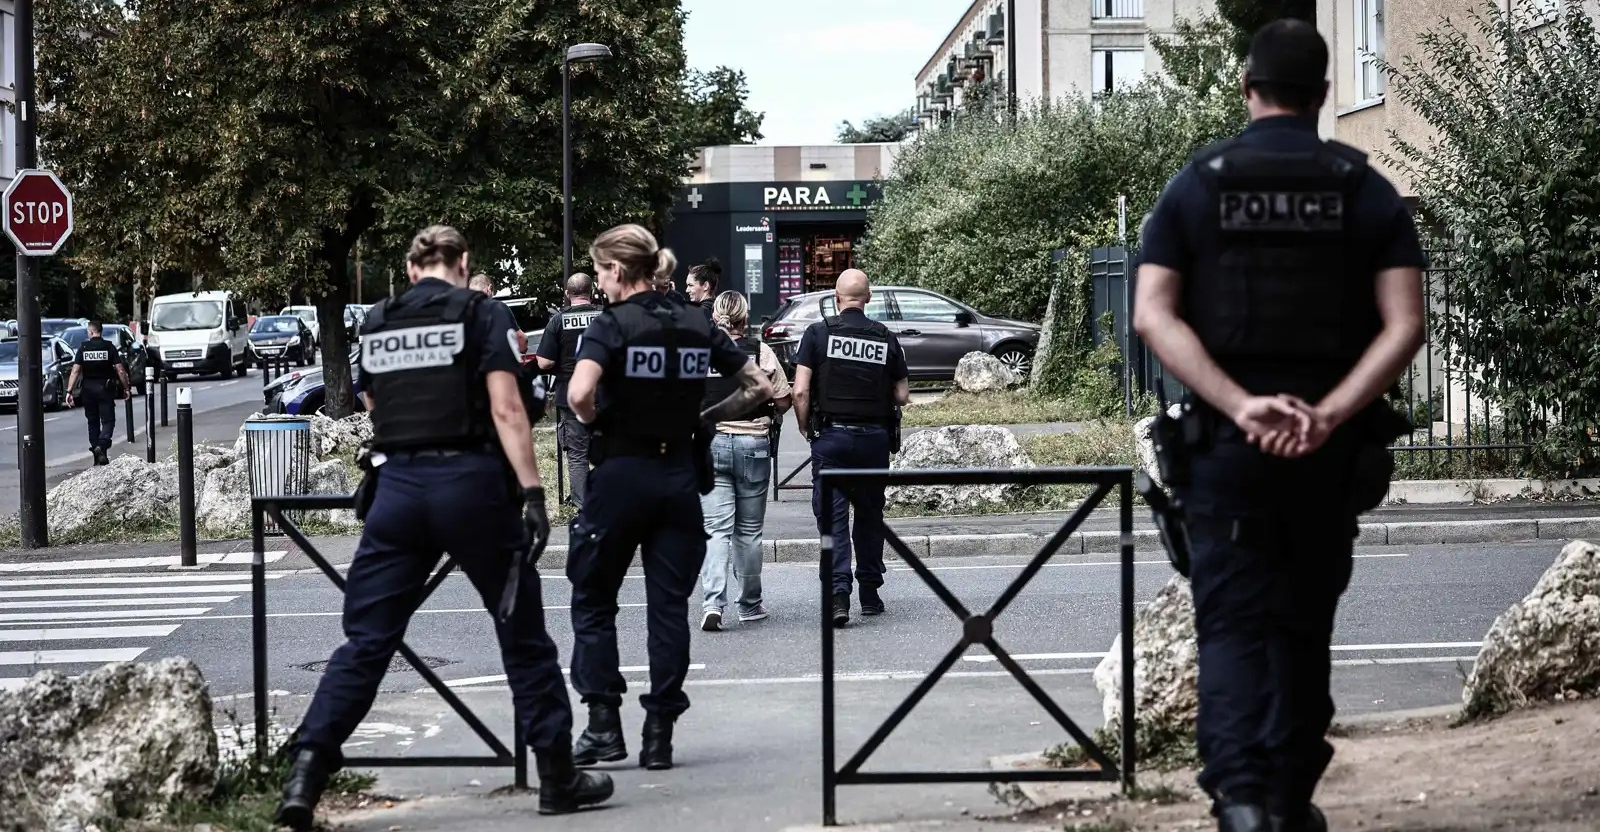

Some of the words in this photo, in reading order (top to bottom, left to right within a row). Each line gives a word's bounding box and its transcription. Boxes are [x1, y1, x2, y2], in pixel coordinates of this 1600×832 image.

[764, 186, 831, 205] PARA
[13, 201, 64, 224] STOP
[1225, 193, 1339, 222] POLICE
[564, 316, 595, 328] POLI
[369, 330, 456, 356] POLICE
[830, 339, 884, 361] POLICE
[84, 352, 107, 360] POLICE
[369, 351, 453, 368] NATIONAL
[631, 351, 708, 374] POCE
